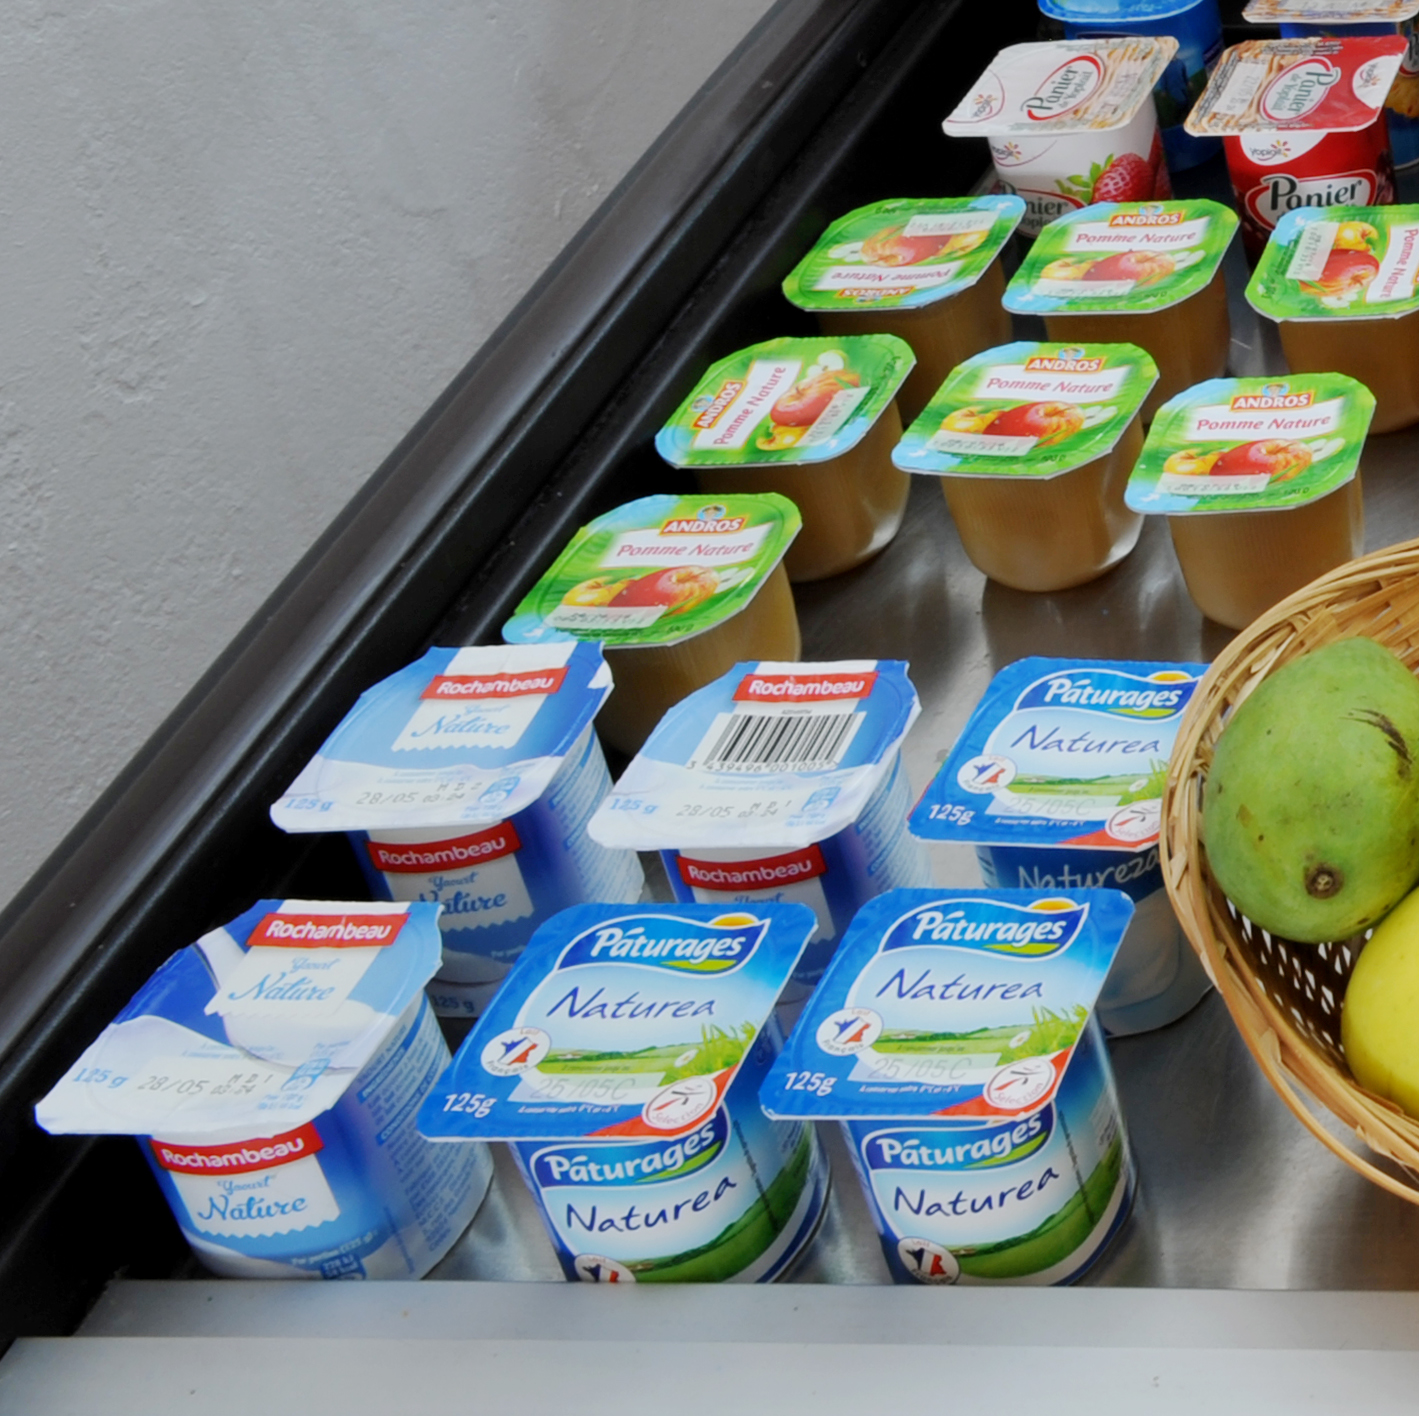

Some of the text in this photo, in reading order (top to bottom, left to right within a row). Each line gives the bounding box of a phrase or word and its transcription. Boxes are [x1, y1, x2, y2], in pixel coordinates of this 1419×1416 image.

[1021, 64, 1080, 112] Panier
[1067, 70, 1094, 105] Yoplait
[1271, 84, 1293, 112] Yoplait
[1287, 66, 1342, 114] Panier
[1262, 173, 1363, 212] Panier
[1111, 213, 1180, 226] ANDROS
[1075, 231, 1196, 244] Pomme Nature
[1398, 228, 1419, 265] Pomme
[831, 267, 952, 282] Pomme Nature
[844, 287, 912, 298] ANDROS
[1027, 358, 1101, 372] ANDROS
[986, 377, 1114, 394] Pomme Nature
[696, 381, 743, 429] ANDROS
[712, 365, 787, 446] Pomme Nature
[1232, 393, 1309, 409] ANDROS
[1196, 415, 1332, 432] Pomme Nature
[663, 518, 743, 533] ANDROS
[616, 541, 755, 558] Pomme Nature
[435, 676, 555, 696] Rochambeau
[748, 679, 866, 696] Rochambeau
[410, 713, 512, 738] Nature
[1010, 723, 1162, 755] Naturea
[355, 791, 419, 806] 28/05
[608, 797, 641, 811] 125
[675, 805, 735, 819] 28/05
[927, 803, 976, 826] 125g
[377, 835, 507, 866] Rochambeau
[687, 858, 813, 883] Rochambeau
[264, 919, 394, 941] Rochambeau
[227, 971, 338, 1002] Nature
[875, 967, 1044, 1001] Naturea
[545, 985, 716, 1019] Naturea
[70, 1067, 110, 1084] 125
[867, 1056, 973, 1079] 25/05C
[136, 1074, 211, 1095] 28/05
[783, 1070, 838, 1097] 125g
[441, 1091, 498, 1118] 125g
[161, 1137, 305, 1169] Rochambeau
[565, 1175, 738, 1234] Naturea
[892, 1166, 1061, 1218] Naturea
[196, 1194, 309, 1222] Nature
